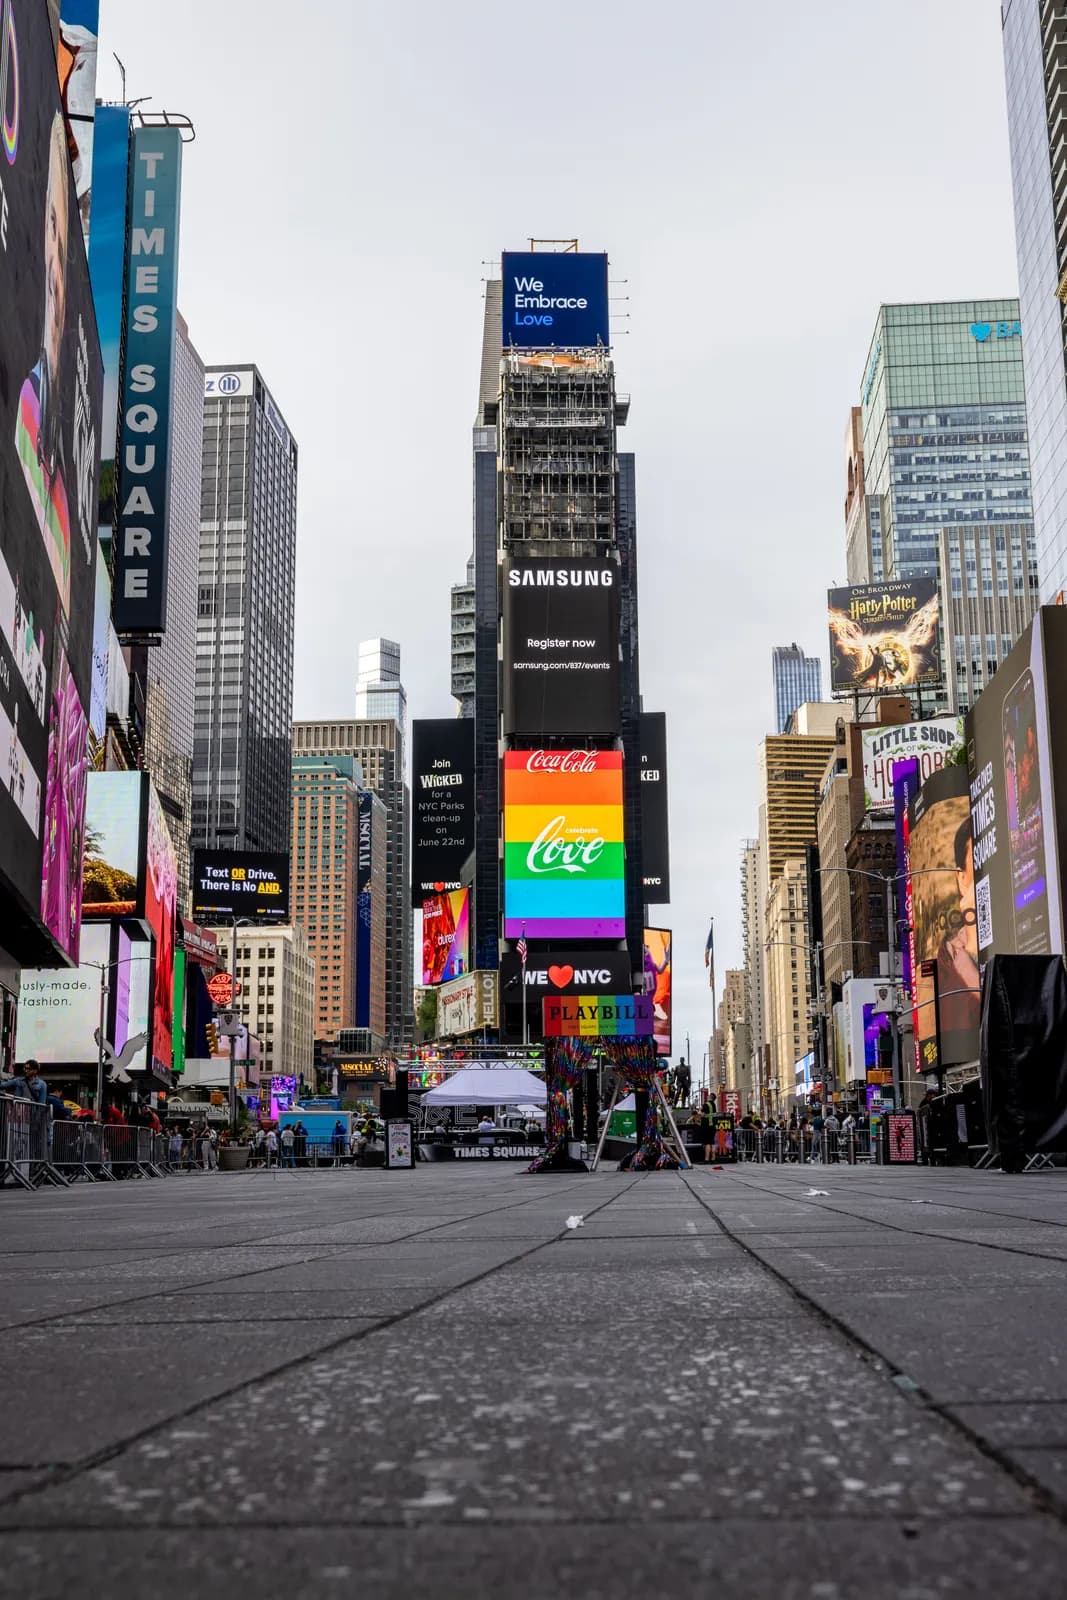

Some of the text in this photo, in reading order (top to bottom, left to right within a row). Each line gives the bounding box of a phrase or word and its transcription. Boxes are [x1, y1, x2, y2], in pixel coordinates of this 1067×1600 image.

[131, 152, 165, 333] TIMES
[514, 276, 544, 292] We
[514, 294, 588, 309] Embrace
[515, 312, 554, 326] Love
[122, 364, 156, 599] SQUARE
[508, 569, 613, 587] SAMSUNG
[848, 594, 918, 621] Harry Potter
[527, 638, 596, 650] Register now
[513, 661, 611, 671] samsung.com/837/events
[872, 726, 956, 757] LITTLE SHOP
[431, 759, 451, 768] Join
[526, 750, 600, 773] Coca-Cola
[969, 761, 993, 801] TAKE OVER
[431, 790, 445, 799] for
[418, 802, 465, 811] NYC Parks
[971, 789, 996, 838] TIMES
[422, 813, 461, 823] clean-up
[418, 837, 465, 847] June 22nd
[526, 815, 605, 873] love
[973, 826, 998, 872] SQUARE
[205, 866, 277, 880] Text OR Drive.
[200, 879, 230, 890] There
[231, 881, 241, 891] Is
[242, 881, 257, 892] No
[421, 881, 462, 890] WE NYC
[437, 932, 456, 946] durex
[523, 969, 612, 985] WE NYC
[482, 973, 495, 1025] HELLO!
[549, 1005, 649, 1020] PLAYBILL
[453, 1146, 539, 1158] TIMES SQUARE
